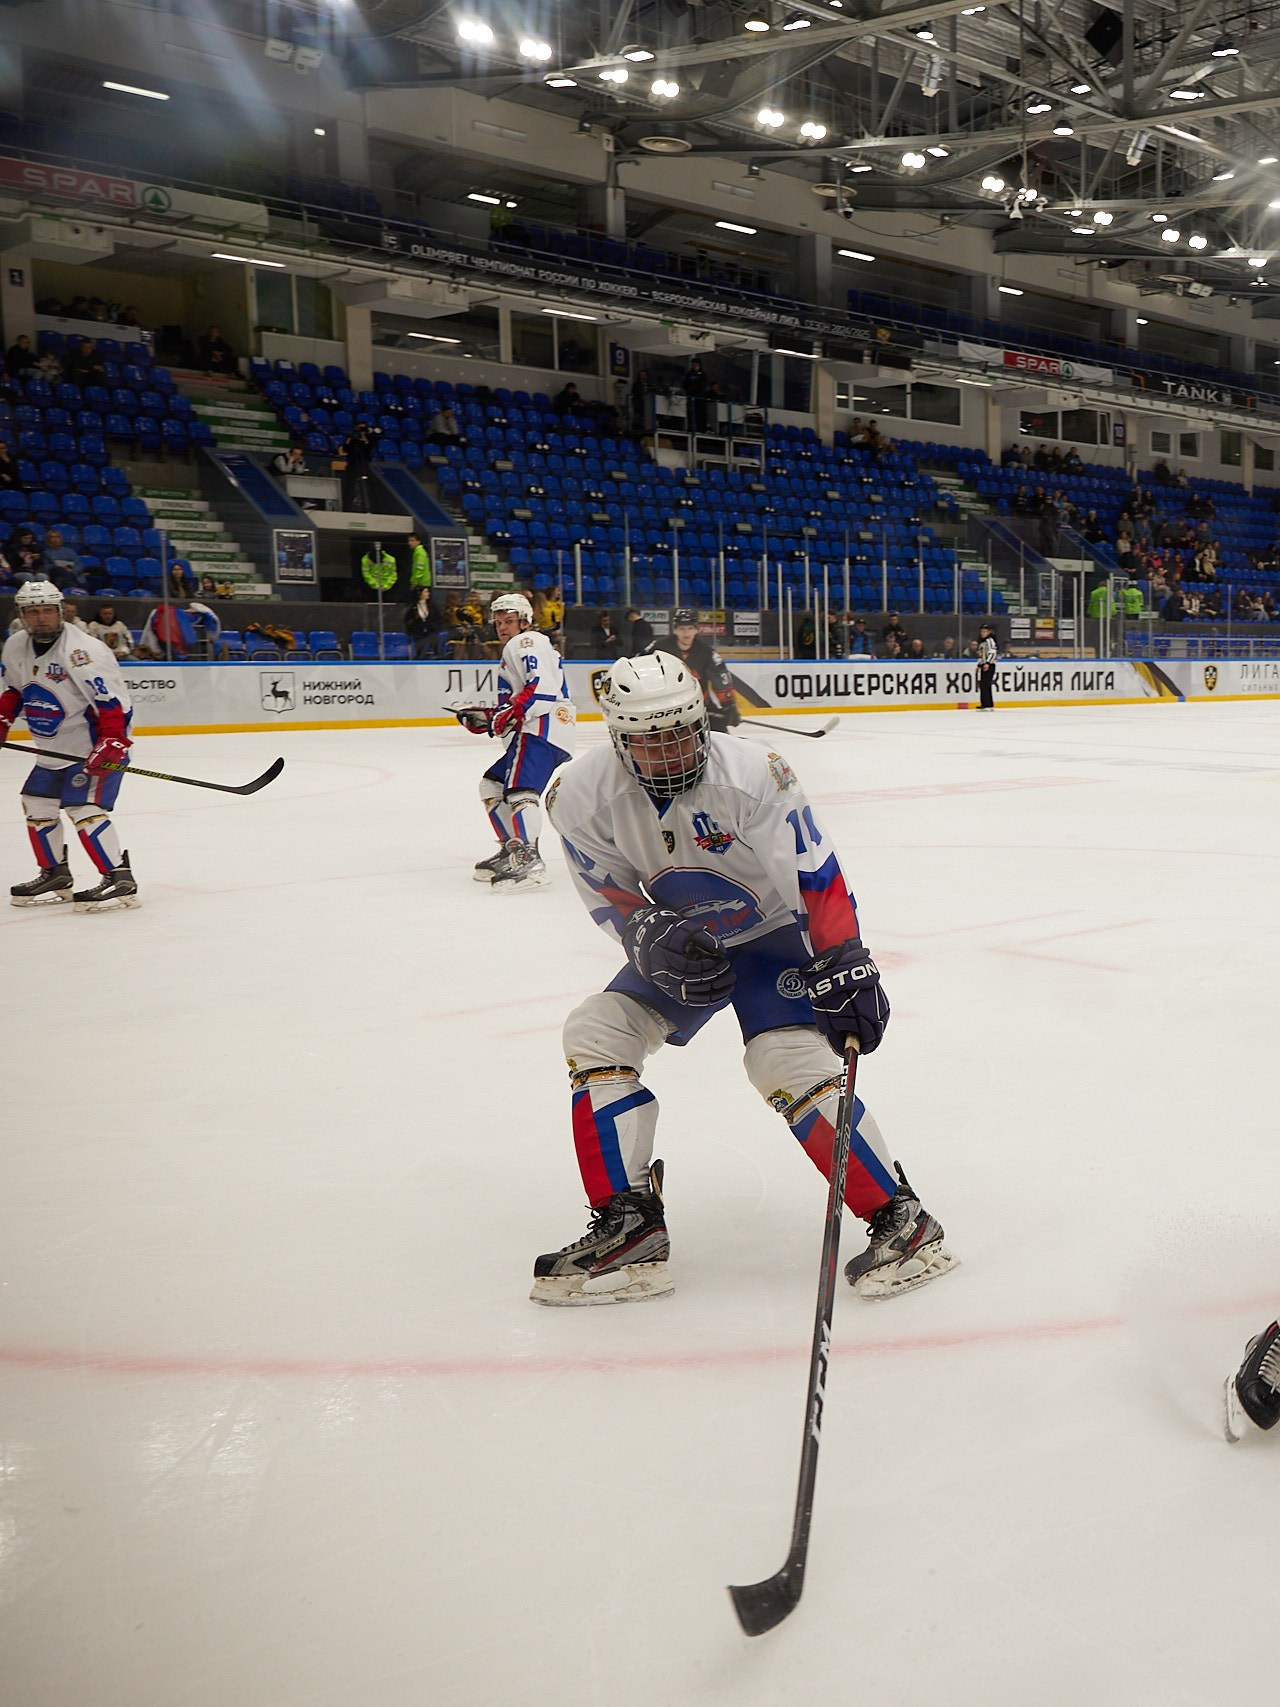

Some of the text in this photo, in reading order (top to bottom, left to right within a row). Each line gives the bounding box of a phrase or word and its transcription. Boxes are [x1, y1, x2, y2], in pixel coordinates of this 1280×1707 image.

[23, 167, 134, 202] SPAR
[471, 256, 536, 278] ЧЕМПИОНАТ
[538, 270, 580, 286] РОССИИ
[581, 278, 596, 289] ПО
[598, 281, 638, 296] ХОККЕЮ
[652, 290, 727, 312] ВСЕРОССИЙСКАЯ
[728, 305, 777, 322] ХОККЕЙНАЯ
[779, 314, 800, 326] ЛИГА
[616, 349, 624, 364] 9
[1016, 356, 1060, 374] SPAR
[1161, 380, 1219, 403] TANK
[1240, 664, 1279, 679] ЛИГА
[303, 678, 362, 690] НИЖНИЙ
[775, 673, 937, 699] ОФИЦЕРСКАЯ
[1071, 671, 1114, 691] ЛИГА
[303, 694, 374, 705] НОВГОРОД
[644, 707, 683, 721] JOFA
[839, 1064, 849, 1097] CCM
[834, 1122, 851, 1217] JETSPEED
